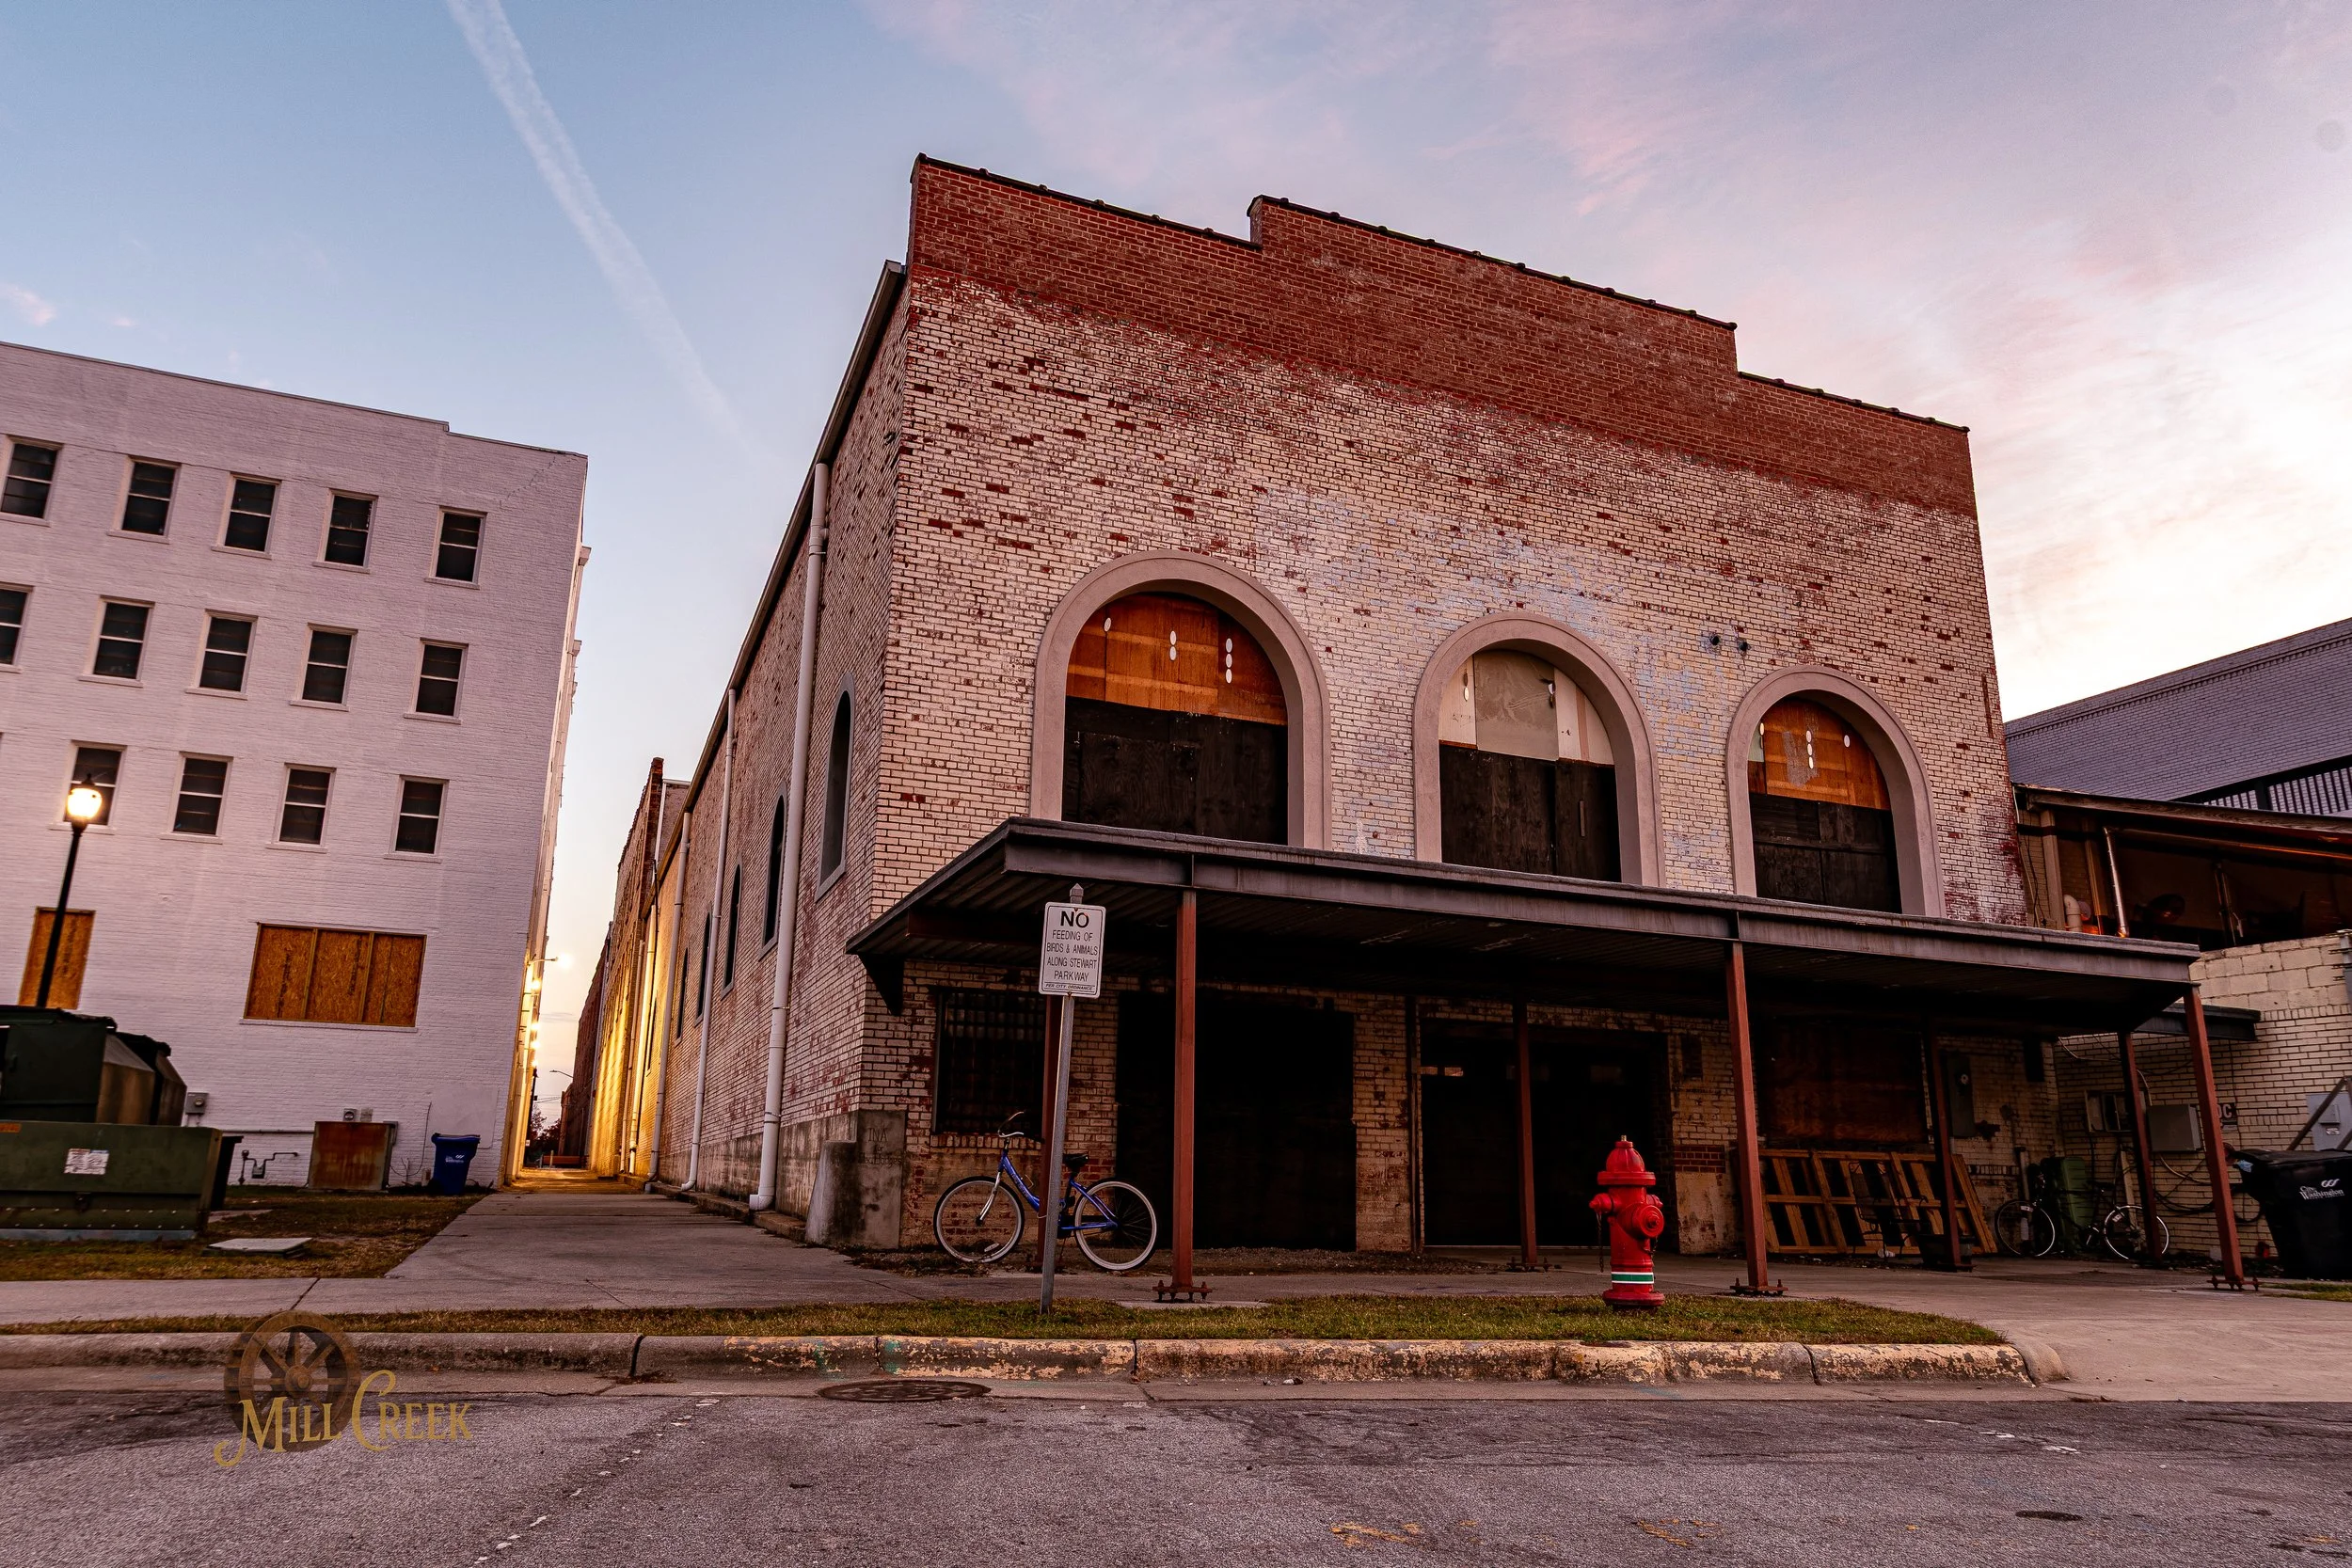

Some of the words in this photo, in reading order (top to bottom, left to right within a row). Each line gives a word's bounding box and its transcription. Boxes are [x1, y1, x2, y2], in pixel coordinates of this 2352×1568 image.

[1060, 911, 1089, 928] NO
[1052, 929, 1081, 942] FEEDING
[1083, 932, 1093, 942] OF
[1046, 942, 1064, 953] BIRDS
[1065, 944, 1071, 954] &
[1073, 944, 1098, 956] ANIMALS
[1046, 957, 1068, 967] ALONG
[1069, 958, 1097, 969] STEWART
[1054, 970, 1089, 982] PARKWAY
